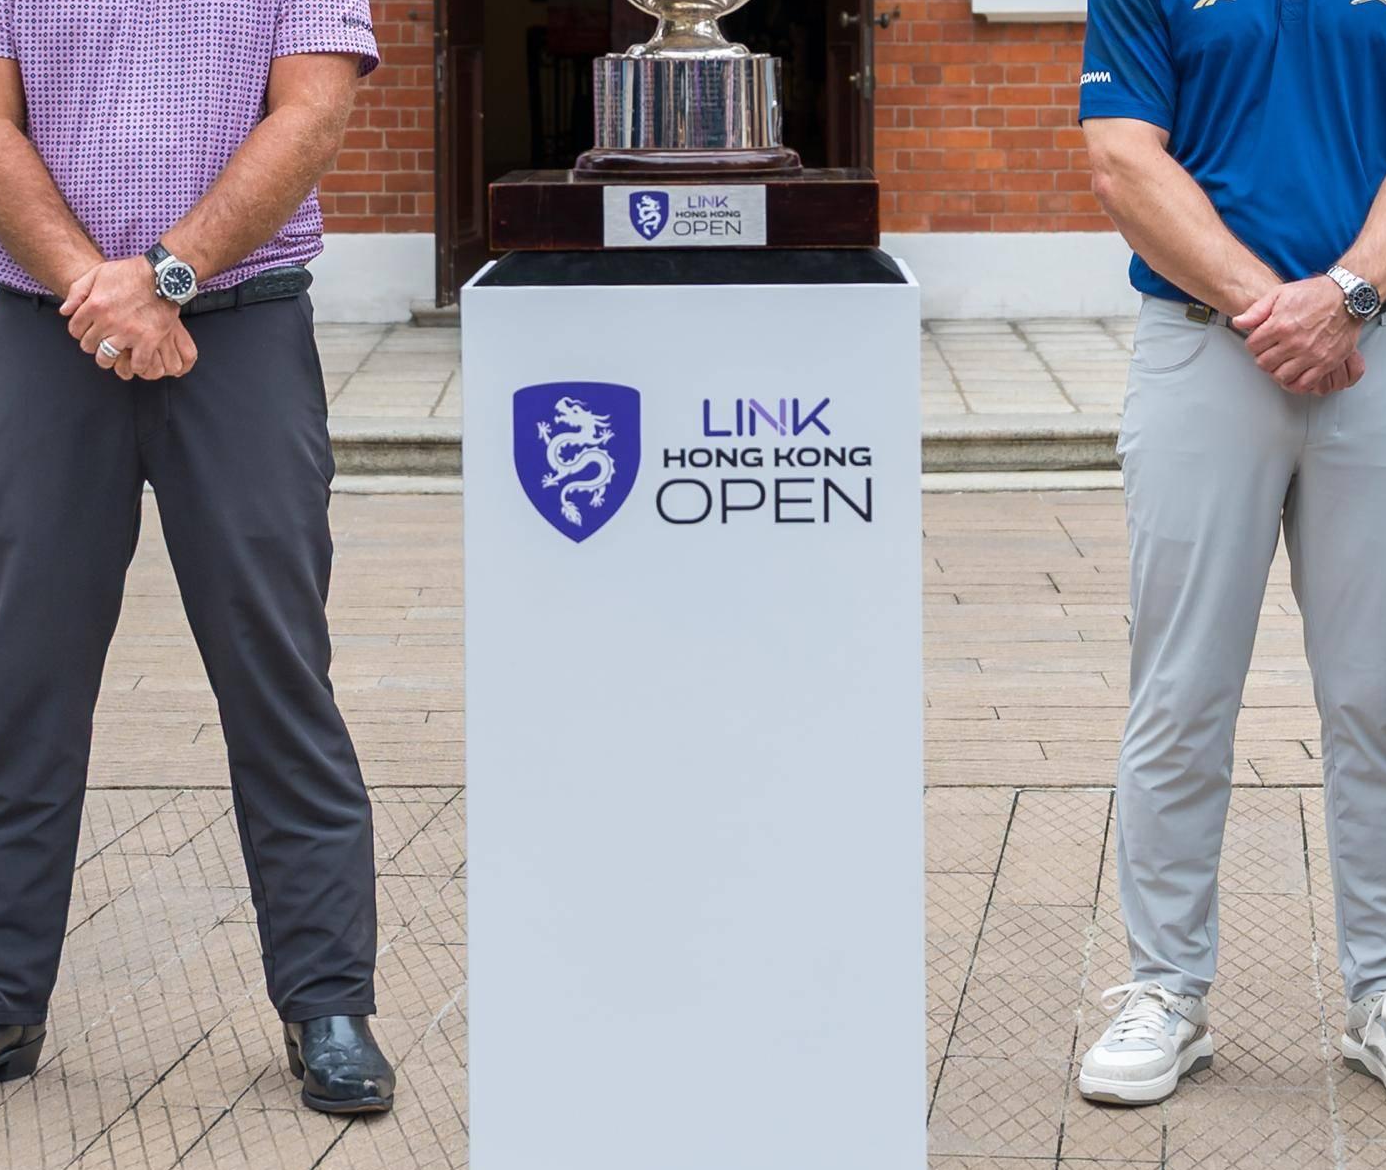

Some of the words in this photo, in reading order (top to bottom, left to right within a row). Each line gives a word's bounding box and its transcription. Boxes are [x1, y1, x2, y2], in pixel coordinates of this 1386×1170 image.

[688, 196, 728, 209] LINK
[675, 210, 708, 219] HONG
[710, 210, 742, 219] KONG
[673, 220, 742, 236] OPEN
[703, 397, 831, 437] LINK
[663, 447, 764, 469] HONG
[774, 446, 872, 468] KONG
[656, 477, 873, 525] OPEN
